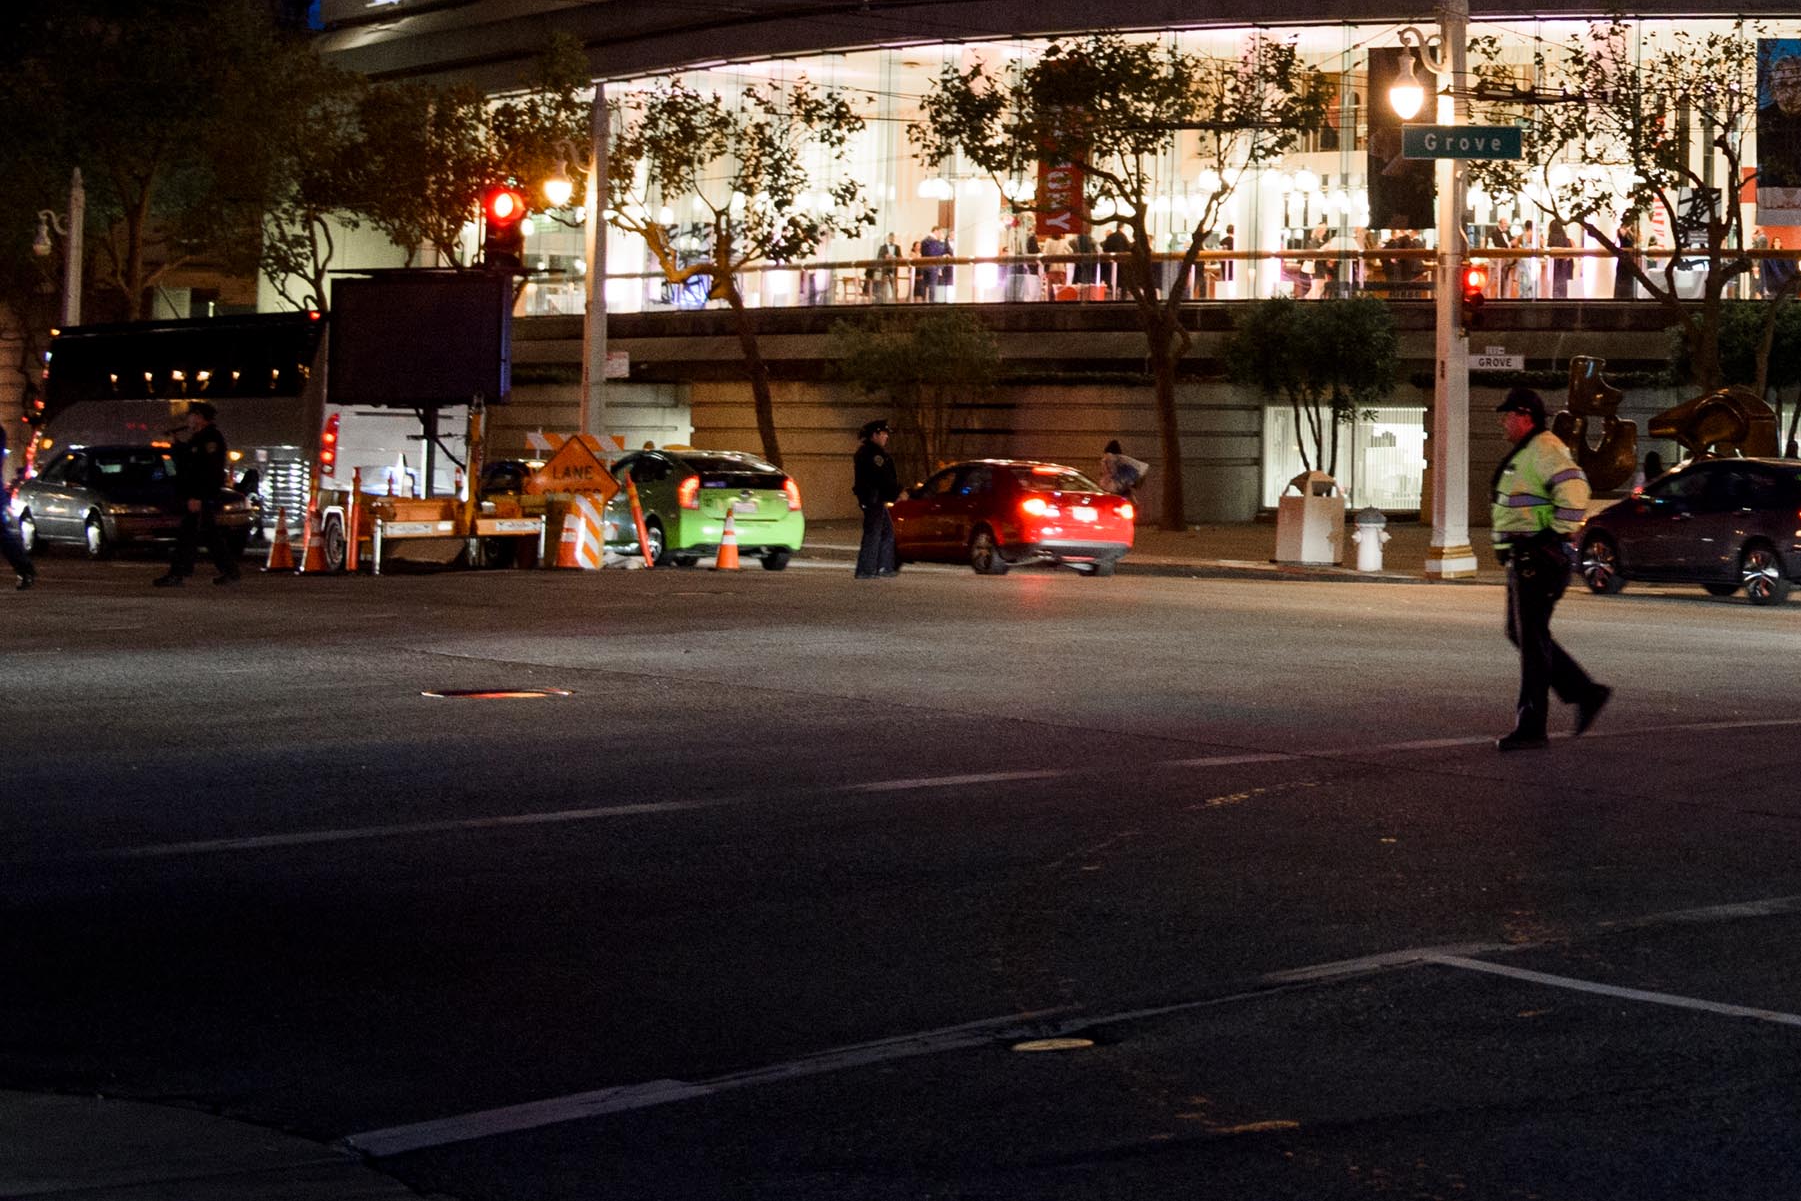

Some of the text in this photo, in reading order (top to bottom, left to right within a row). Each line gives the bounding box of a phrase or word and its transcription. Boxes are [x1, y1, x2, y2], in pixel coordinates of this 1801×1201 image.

[1424, 132, 1501, 151] Grove
[1478, 357, 1512, 368] GROVE
[553, 465, 594, 480] LANE
